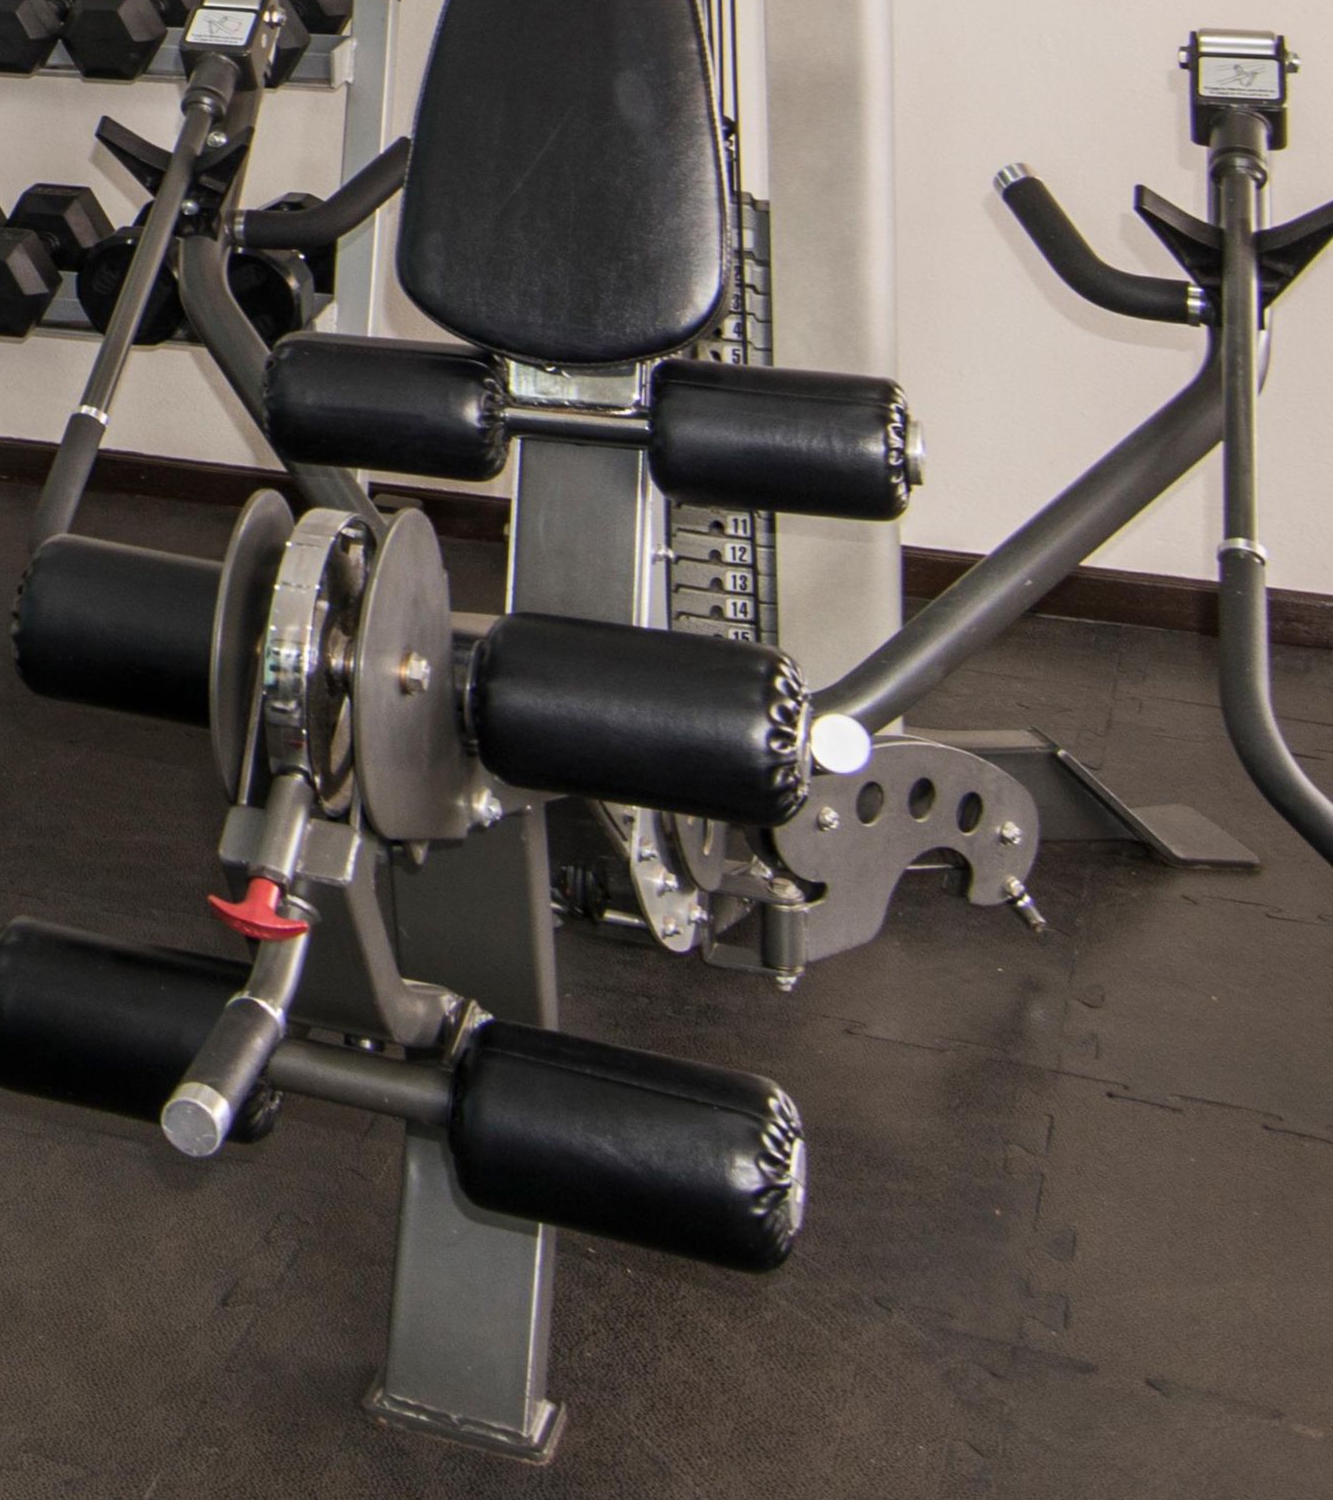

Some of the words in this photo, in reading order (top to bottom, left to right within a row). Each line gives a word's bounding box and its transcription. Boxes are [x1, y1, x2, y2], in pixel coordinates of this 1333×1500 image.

[733, 321, 745, 338] 4
[731, 348, 742, 364] 5
[732, 518, 748, 535] 11
[731, 545, 747, 562] 12
[731, 574, 748, 591] 13
[731, 601, 748, 617] 14
